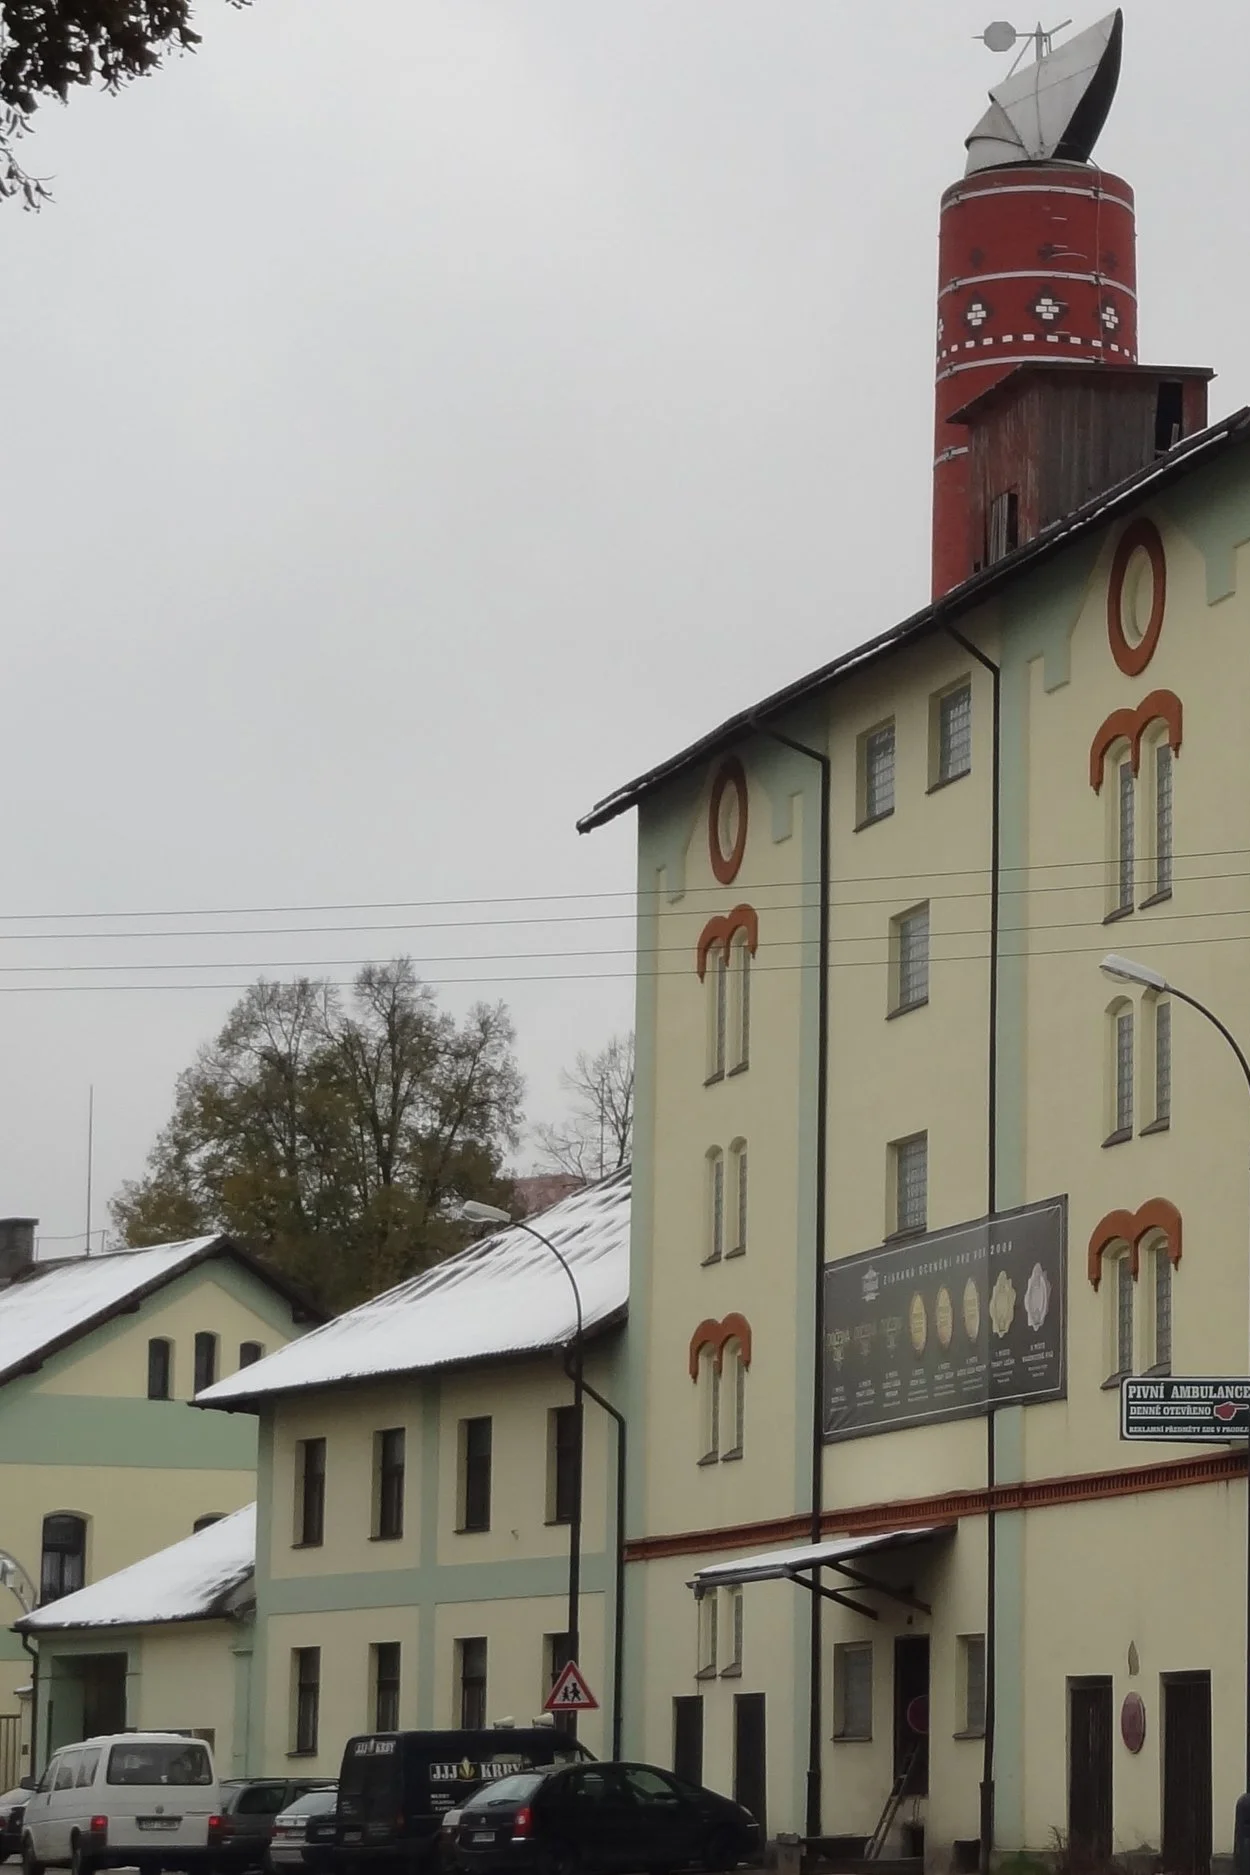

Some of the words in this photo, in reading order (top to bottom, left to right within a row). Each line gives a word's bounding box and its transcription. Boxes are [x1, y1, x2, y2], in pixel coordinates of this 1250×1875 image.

[1128, 1382, 1164, 1399] PIVNÍ
[1171, 1385, 1250, 1399] AMBULANCE
[1163, 1404, 1211, 1416] OTEVŘENO
[433, 1765, 458, 1779] JJJ
